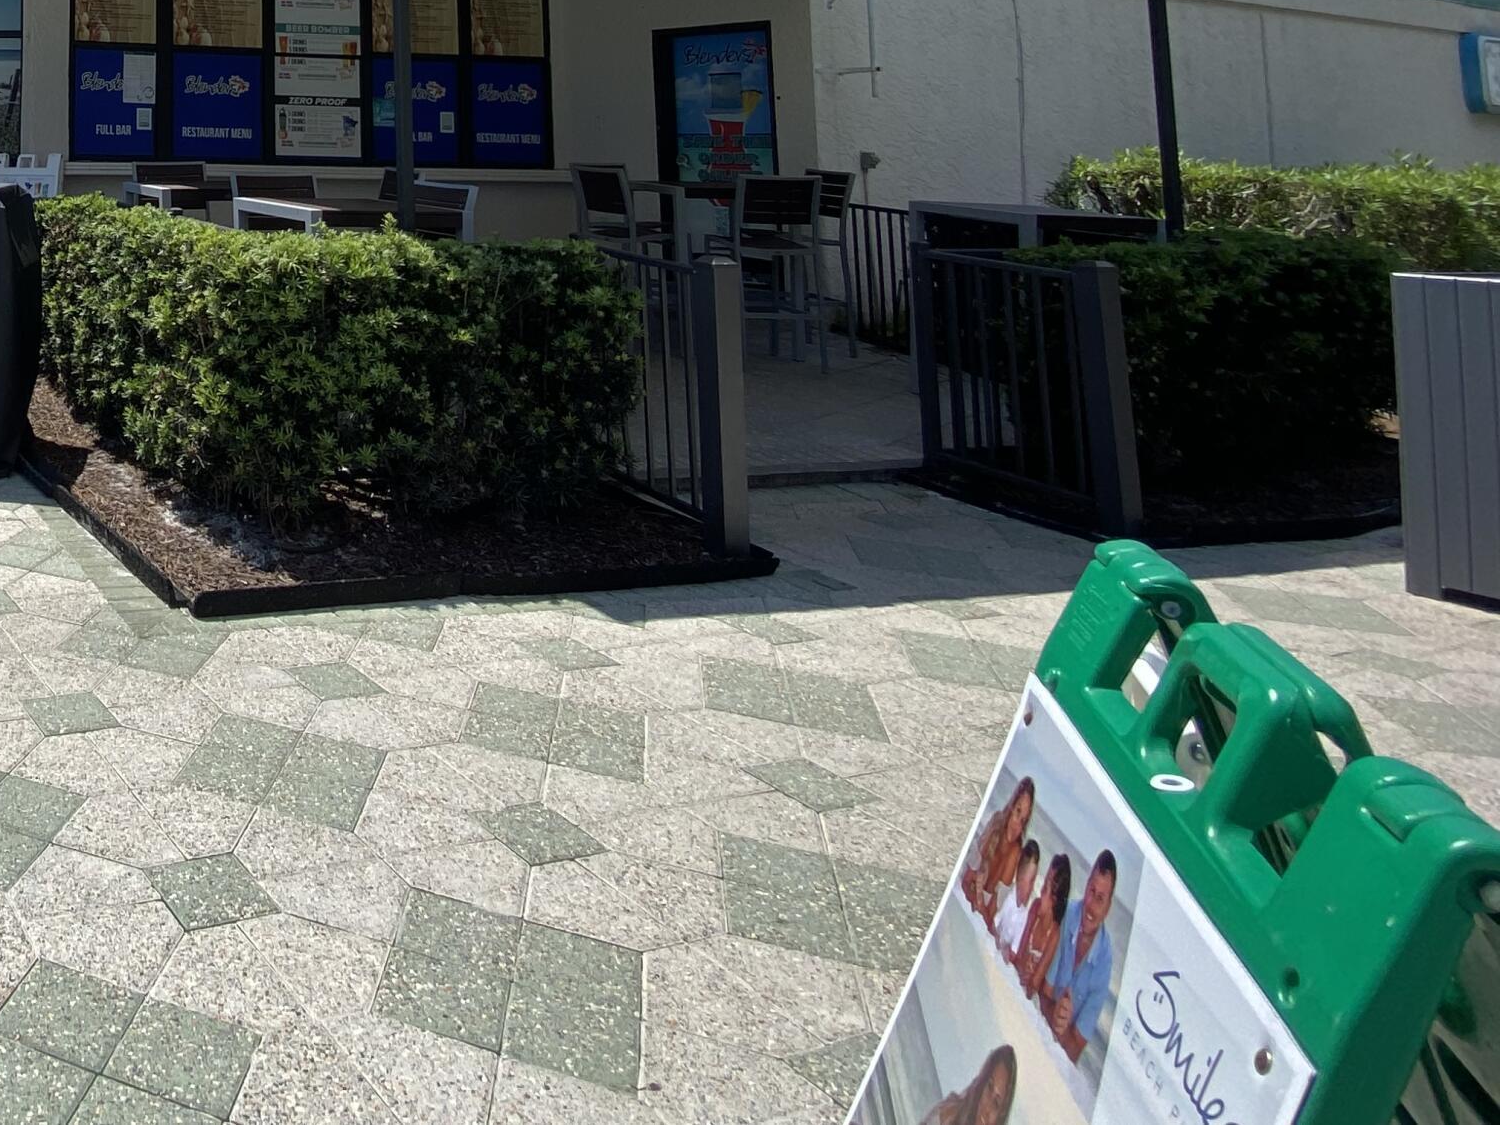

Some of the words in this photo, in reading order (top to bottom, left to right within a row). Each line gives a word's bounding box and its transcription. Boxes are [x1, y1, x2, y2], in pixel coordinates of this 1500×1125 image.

[288, 97, 313, 105] ZERO
[314, 97, 348, 106] PROOF
[95, 124, 114, 136] FULL
[115, 124, 132, 136] BAR
[181, 126, 230, 139] RESTAURANT
[231, 127, 252, 139] MENU
